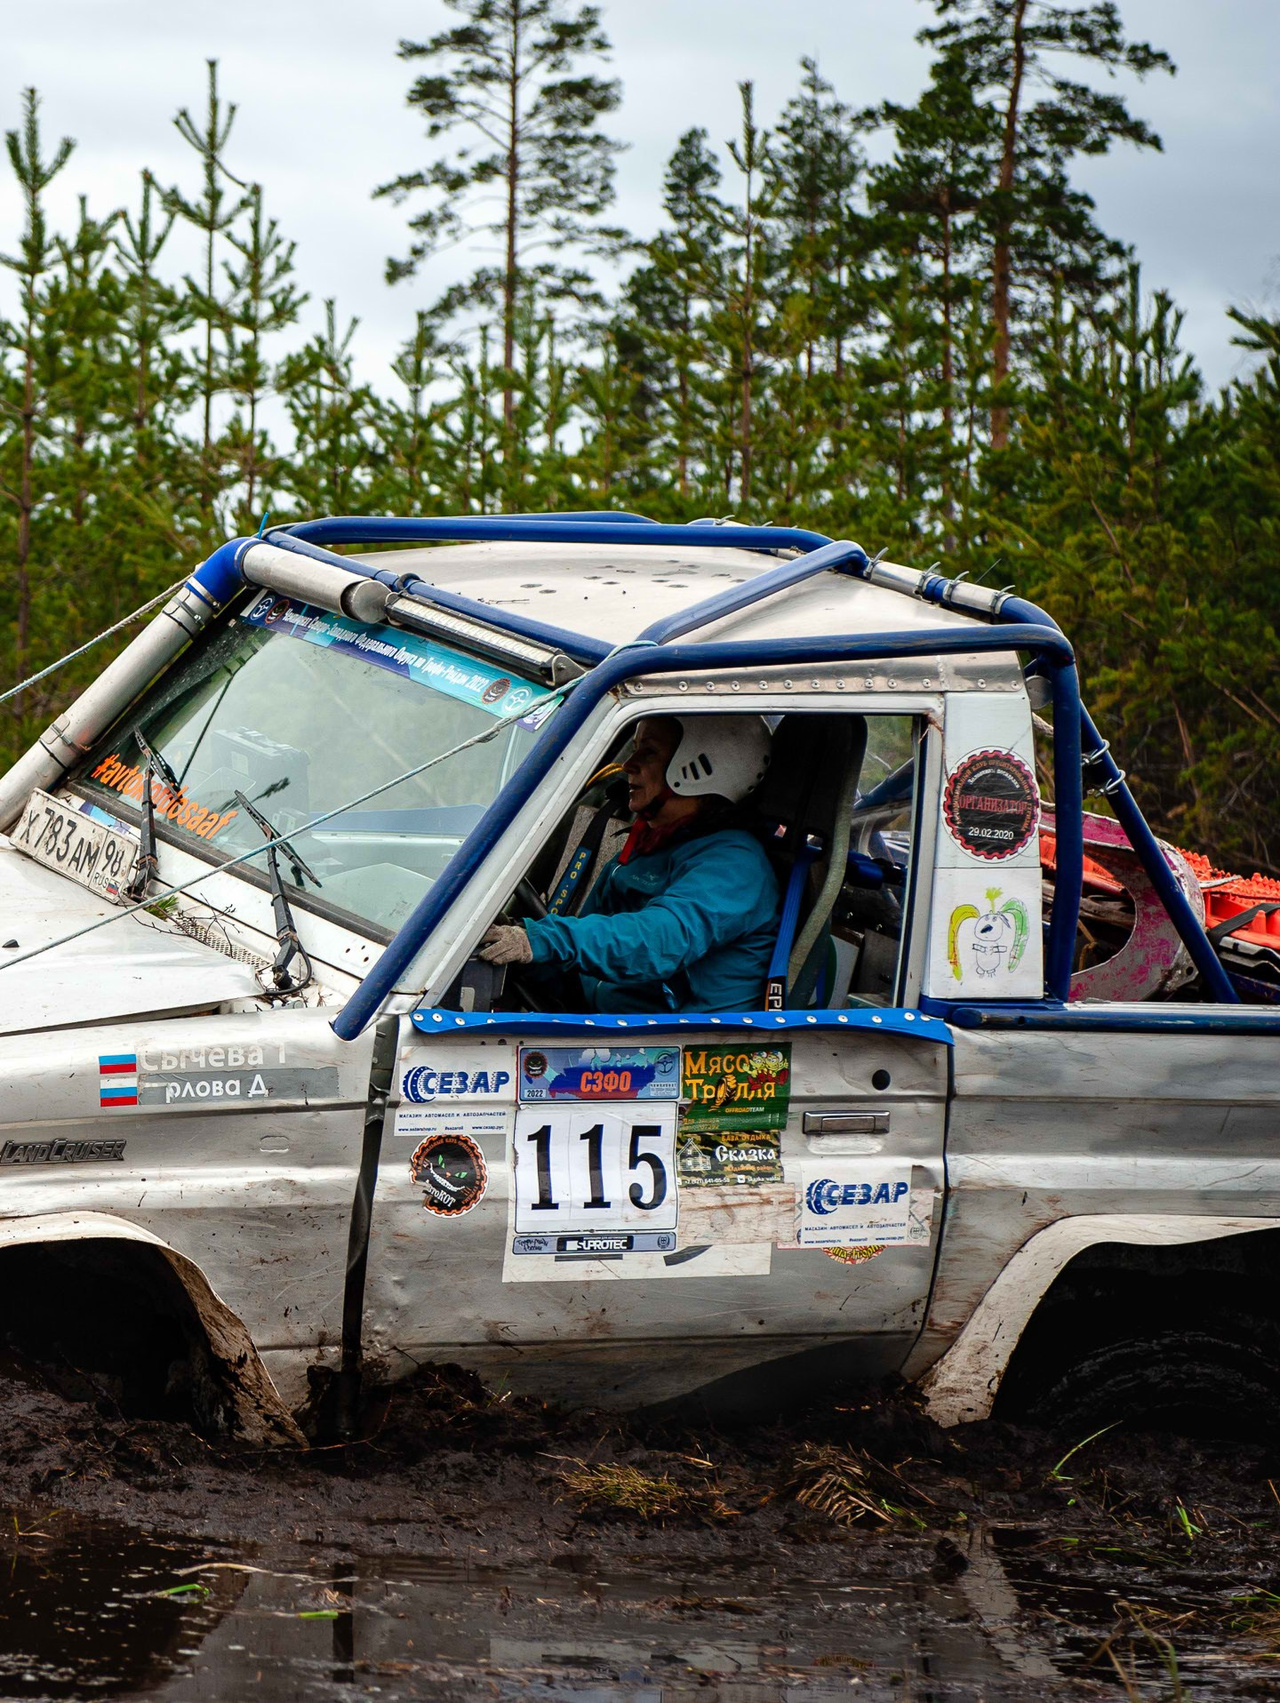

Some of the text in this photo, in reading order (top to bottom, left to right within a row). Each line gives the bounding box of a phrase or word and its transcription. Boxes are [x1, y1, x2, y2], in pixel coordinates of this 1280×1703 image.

[355, 631, 398, 658] Федерального
[394, 646, 418, 665] Округа
[414, 657, 427, 669] по
[465, 674, 490, 693] 2022
[960, 795, 1028, 815] ОРГАНИЗАТОР
[968, 826, 1014, 840] 29.02.2020
[93, 872, 109, 889] RUS
[684, 1051, 750, 1078] Мясо
[248, 1073, 269, 1098] Д
[419, 1071, 510, 1094] СЕЗАР
[580, 1071, 632, 1093] СЗФО
[526, 1089, 544, 1098] 2022
[741, 1134, 772, 1142] ОТДЫХА
[1, 1140, 51, 1163] LAND
[49, 1138, 125, 1161] CRUISER
[715, 1145, 777, 1162] Сказка
[527, 1123, 668, 1211] 115
[823, 1182, 909, 1206] СЕЗАР
[577, 1239, 628, 1250] SUPROTEC
